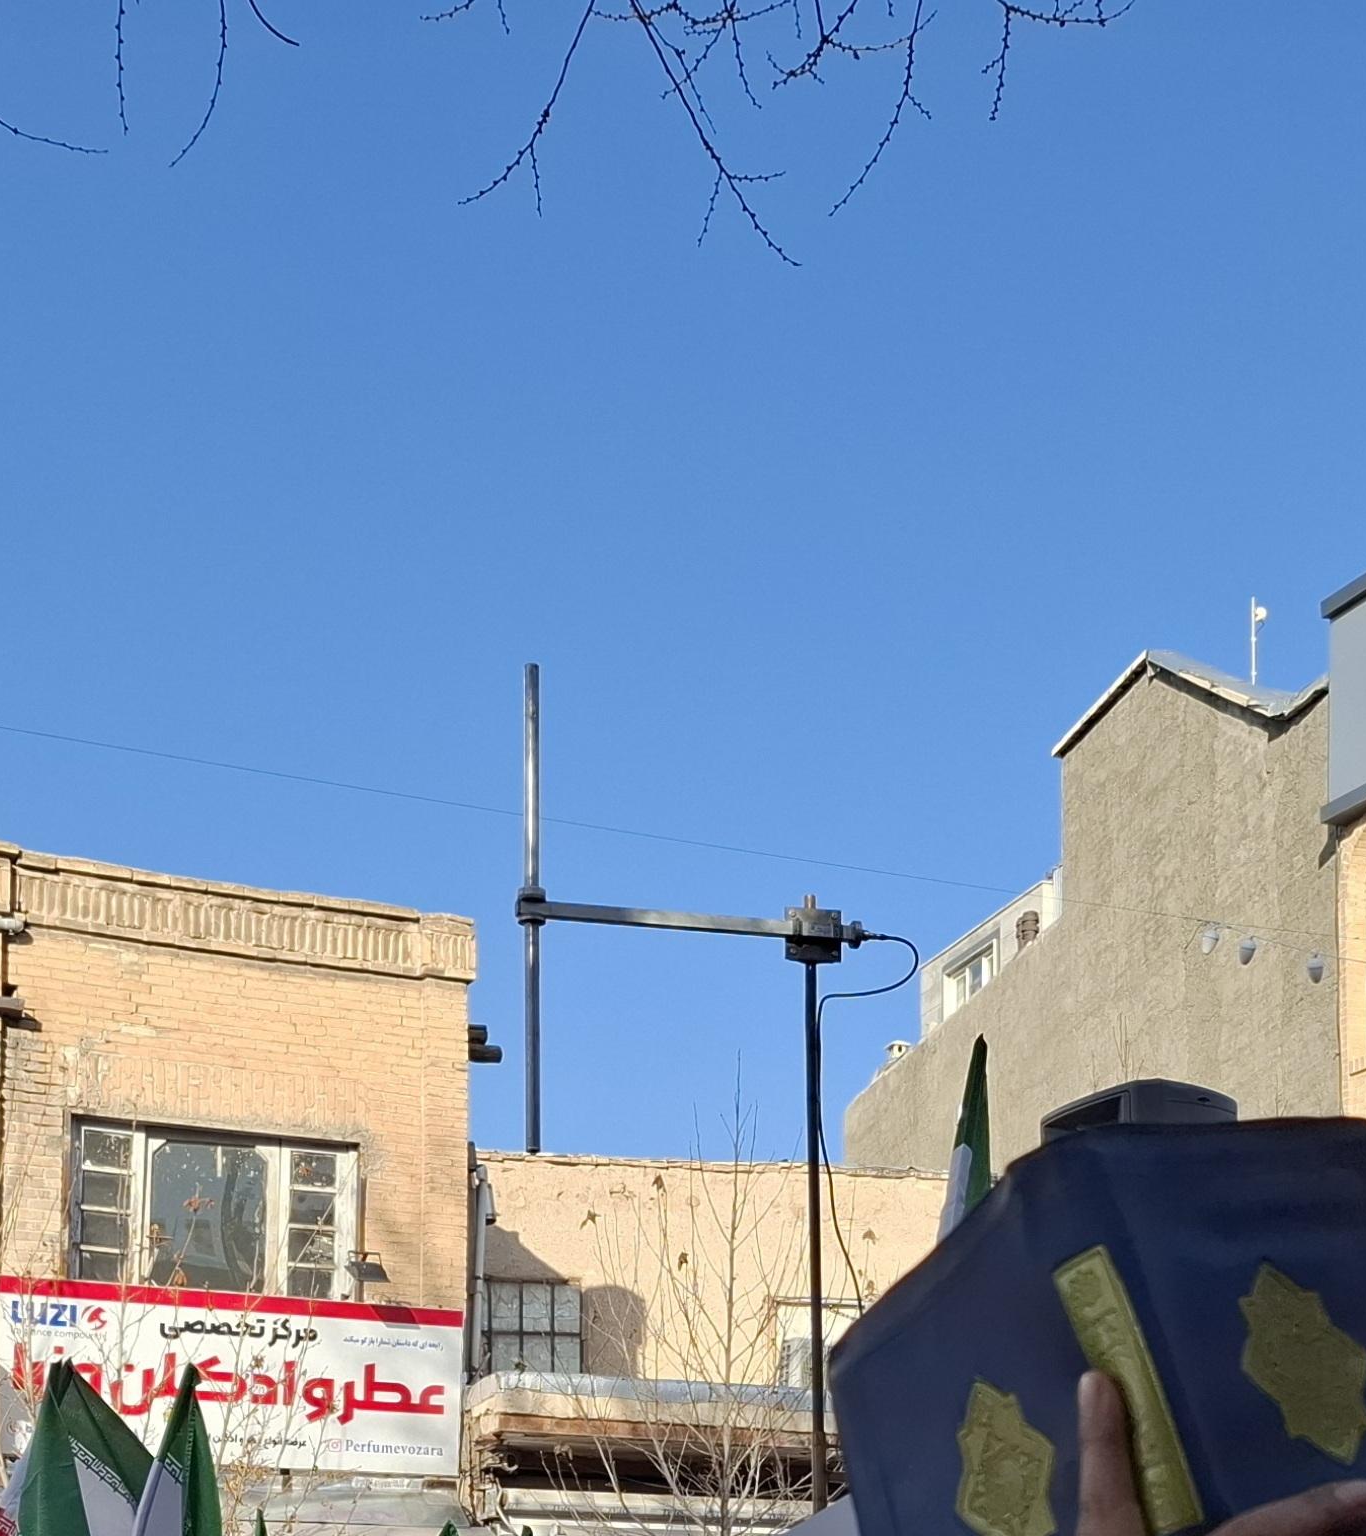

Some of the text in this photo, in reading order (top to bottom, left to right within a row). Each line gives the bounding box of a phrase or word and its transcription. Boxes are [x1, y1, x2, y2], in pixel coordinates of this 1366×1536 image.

[12, 1300, 77, 1327] LUZI
[159, 1317, 319, 1349] مرکز تخصصی
[109, 1350, 297, 1416] ادکلن
[302, 1377, 335, 1424] و
[336, 1363, 445, 1426] عطر
[345, 1438, 444, 1457] Perfumevozara
